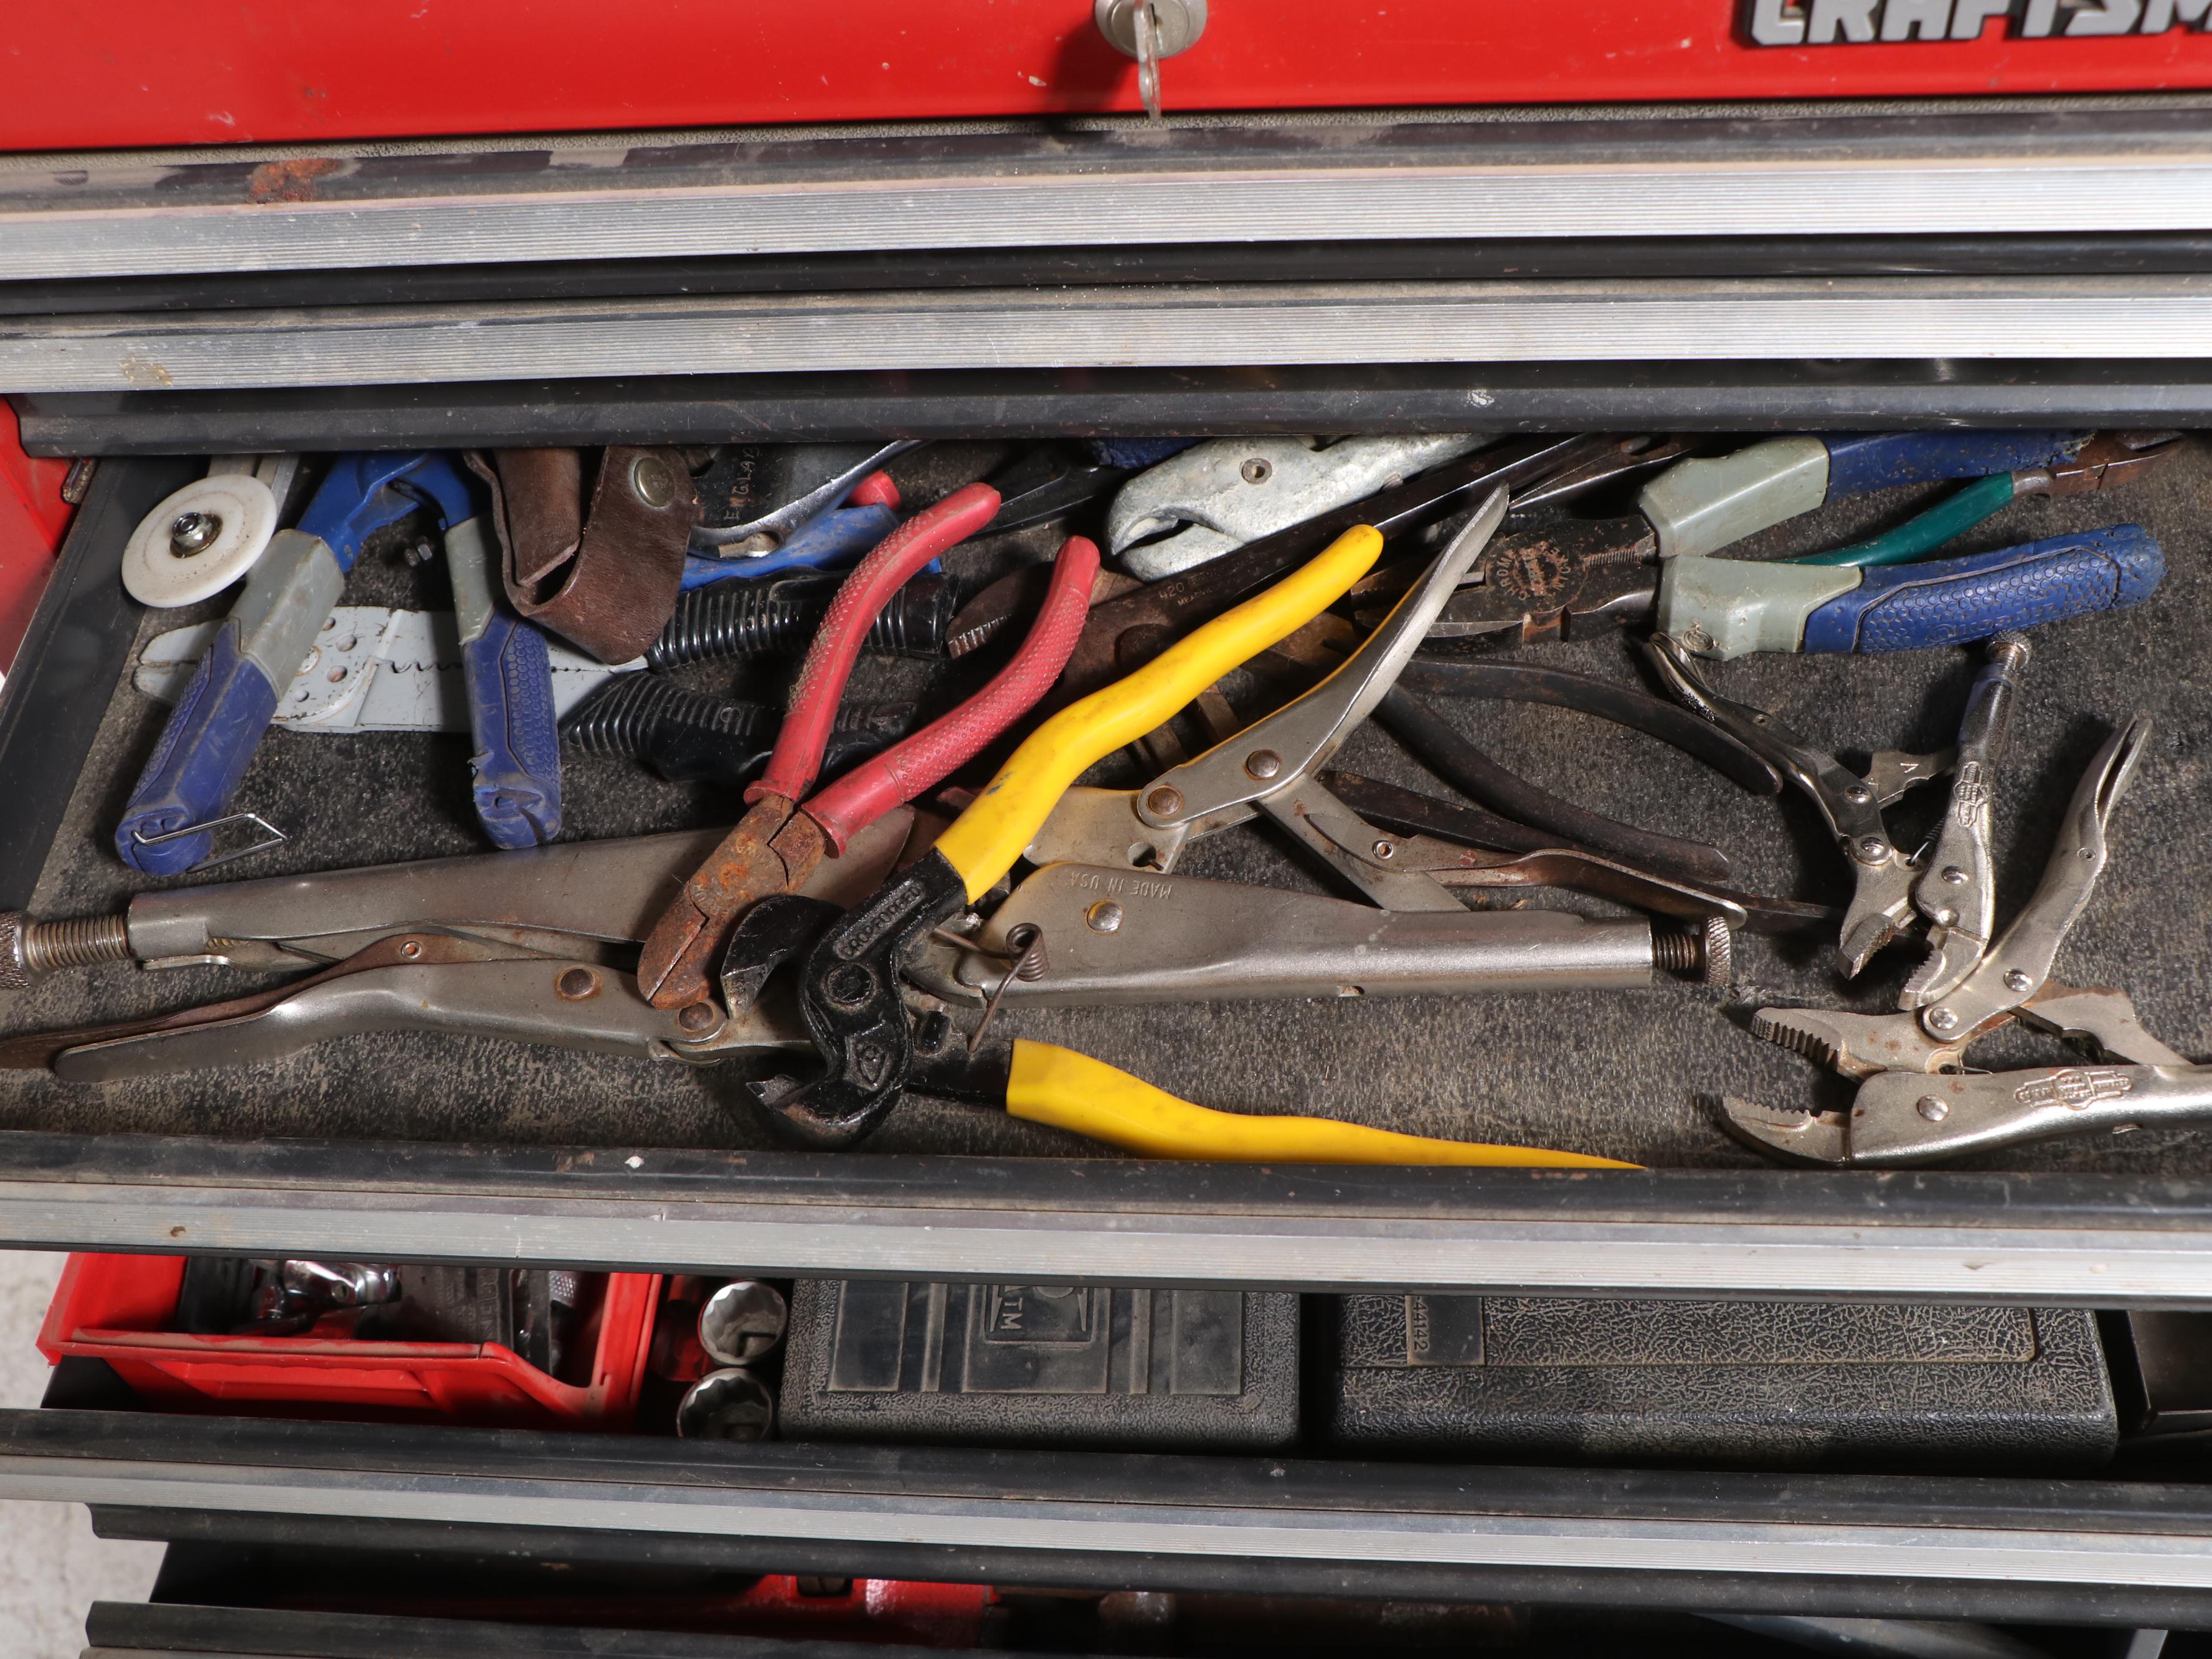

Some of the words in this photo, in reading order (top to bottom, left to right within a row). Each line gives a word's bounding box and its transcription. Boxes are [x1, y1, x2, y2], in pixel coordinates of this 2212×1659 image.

[1159, 582, 1184, 600] 420
[1071, 872, 1099, 890] USA
[1107, 877, 1125, 892] IN
[1130, 879, 1173, 900] MADE
[1000, 1297, 1023, 1330] TM
